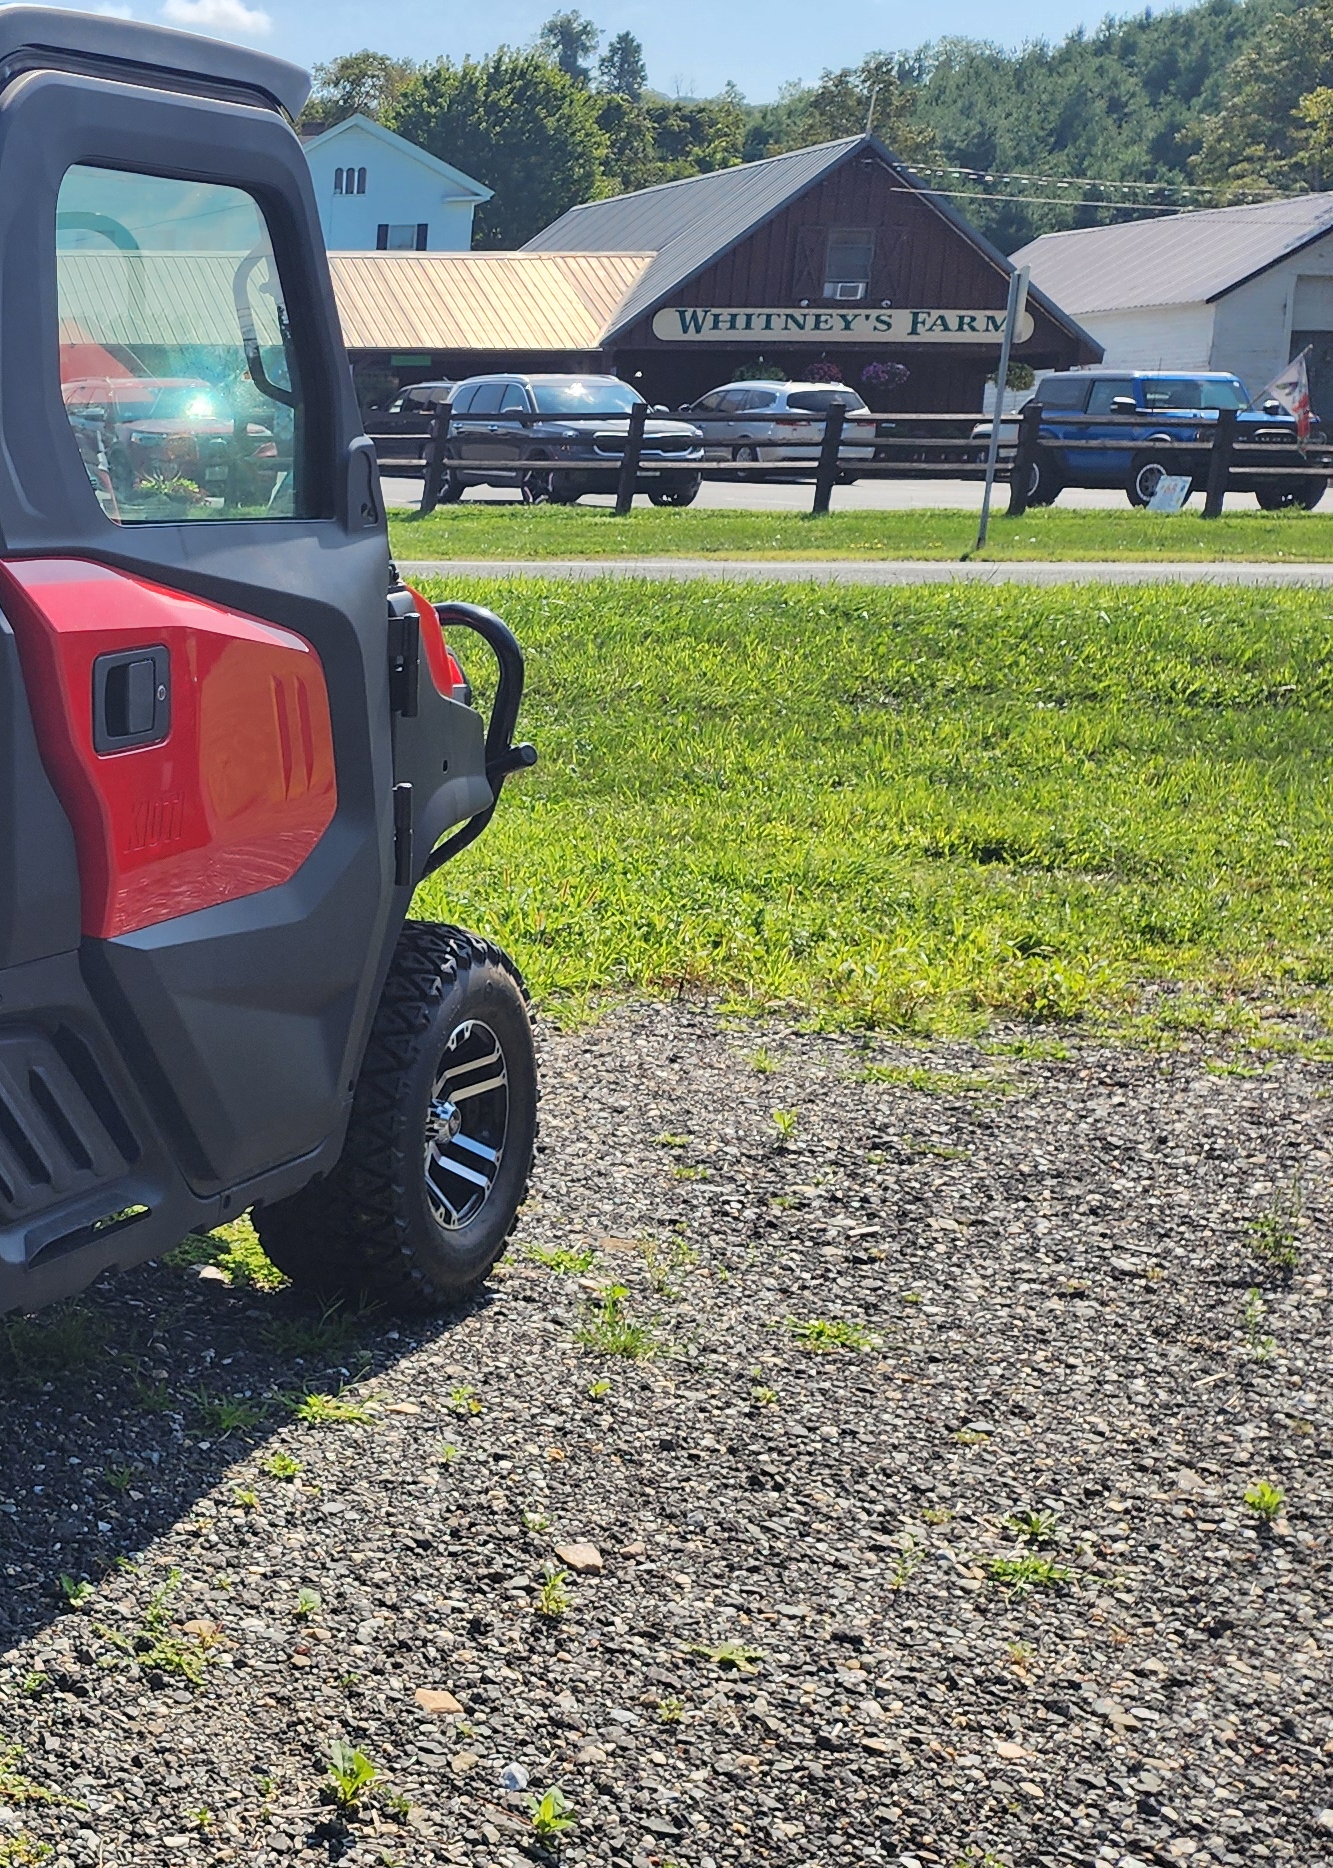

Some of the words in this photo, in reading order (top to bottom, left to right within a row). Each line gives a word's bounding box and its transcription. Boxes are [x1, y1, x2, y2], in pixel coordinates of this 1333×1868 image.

[675, 309, 893, 335] WHITNEY'S
[907, 310, 1008, 336] FARM
[123, 789, 186, 853] KIOTI
